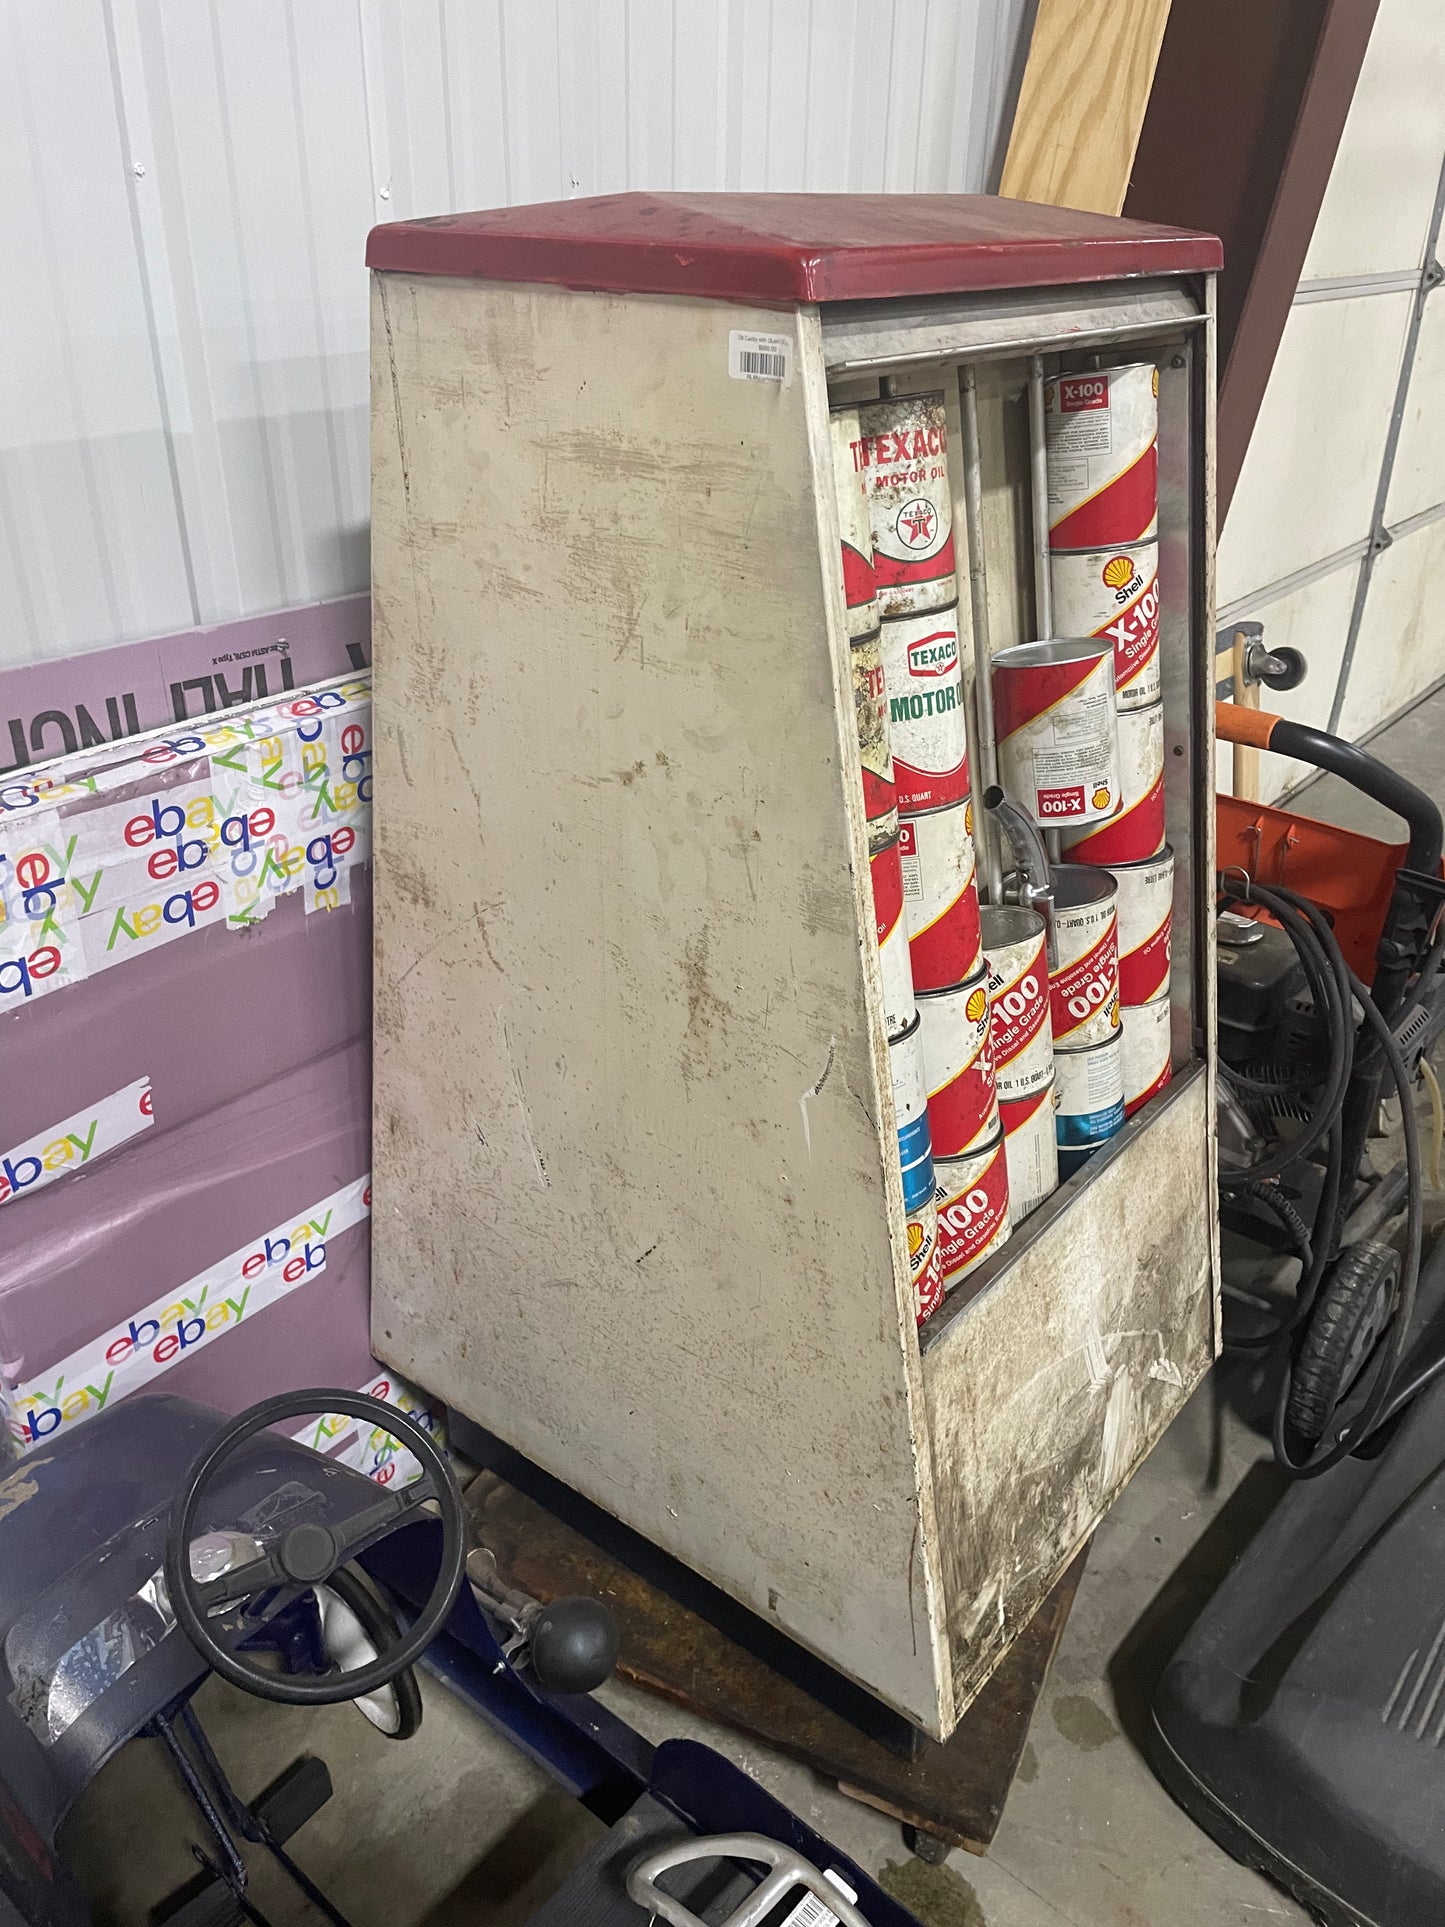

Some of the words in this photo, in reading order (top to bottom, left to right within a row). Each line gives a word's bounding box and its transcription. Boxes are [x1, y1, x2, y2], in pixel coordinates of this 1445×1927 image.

[1064, 382, 1104, 399] X-100
[876, 471, 926, 489] MOTOR
[930, 466, 945, 480] OIL
[903, 507, 931, 519] TEXACO
[1115, 575, 1144, 604] Shell
[1105, 578, 1159, 652] X-100
[218, 653, 234, 663] Type
[911, 641, 956, 667] TEXACO
[1125, 629, 1152, 659] Single
[211, 657, 218, 666] X
[865, 665, 885, 699] TE
[889, 688, 956, 722] MOTOR
[912, 791, 932, 803] QUART
[1093, 779, 1108, 789] Shell
[124, 787, 239, 848] ebay
[1042, 798, 1081, 812] X-100
[258, 825, 356, 888] ebay
[106, 880, 220, 952] ebay
[878, 923, 887, 934] Oil
[1093, 942, 1116, 973] Single
[1060, 967, 1085, 985] Gasoline
[1061, 973, 1094, 998] Grade
[1019, 995, 1044, 1026] Grade
[1001, 1041, 1020, 1057] Diesel
[1020, 1031, 1029, 1043] and
[1004, 1080, 1013, 1090] OIL
[1020, 1076, 1029, 1087] U.S.
[965, 1208, 995, 1239] Grade
[242, 1208, 333, 1280] ebay
[910, 1235, 932, 1271] Shell
[946, 1252, 965, 1267] Diesel
[965, 1244, 976, 1255] and
[975, 1222, 996, 1245] Gasoline
[106, 1284, 209, 1366] ebay
[153, 1284, 252, 1364] ebay
